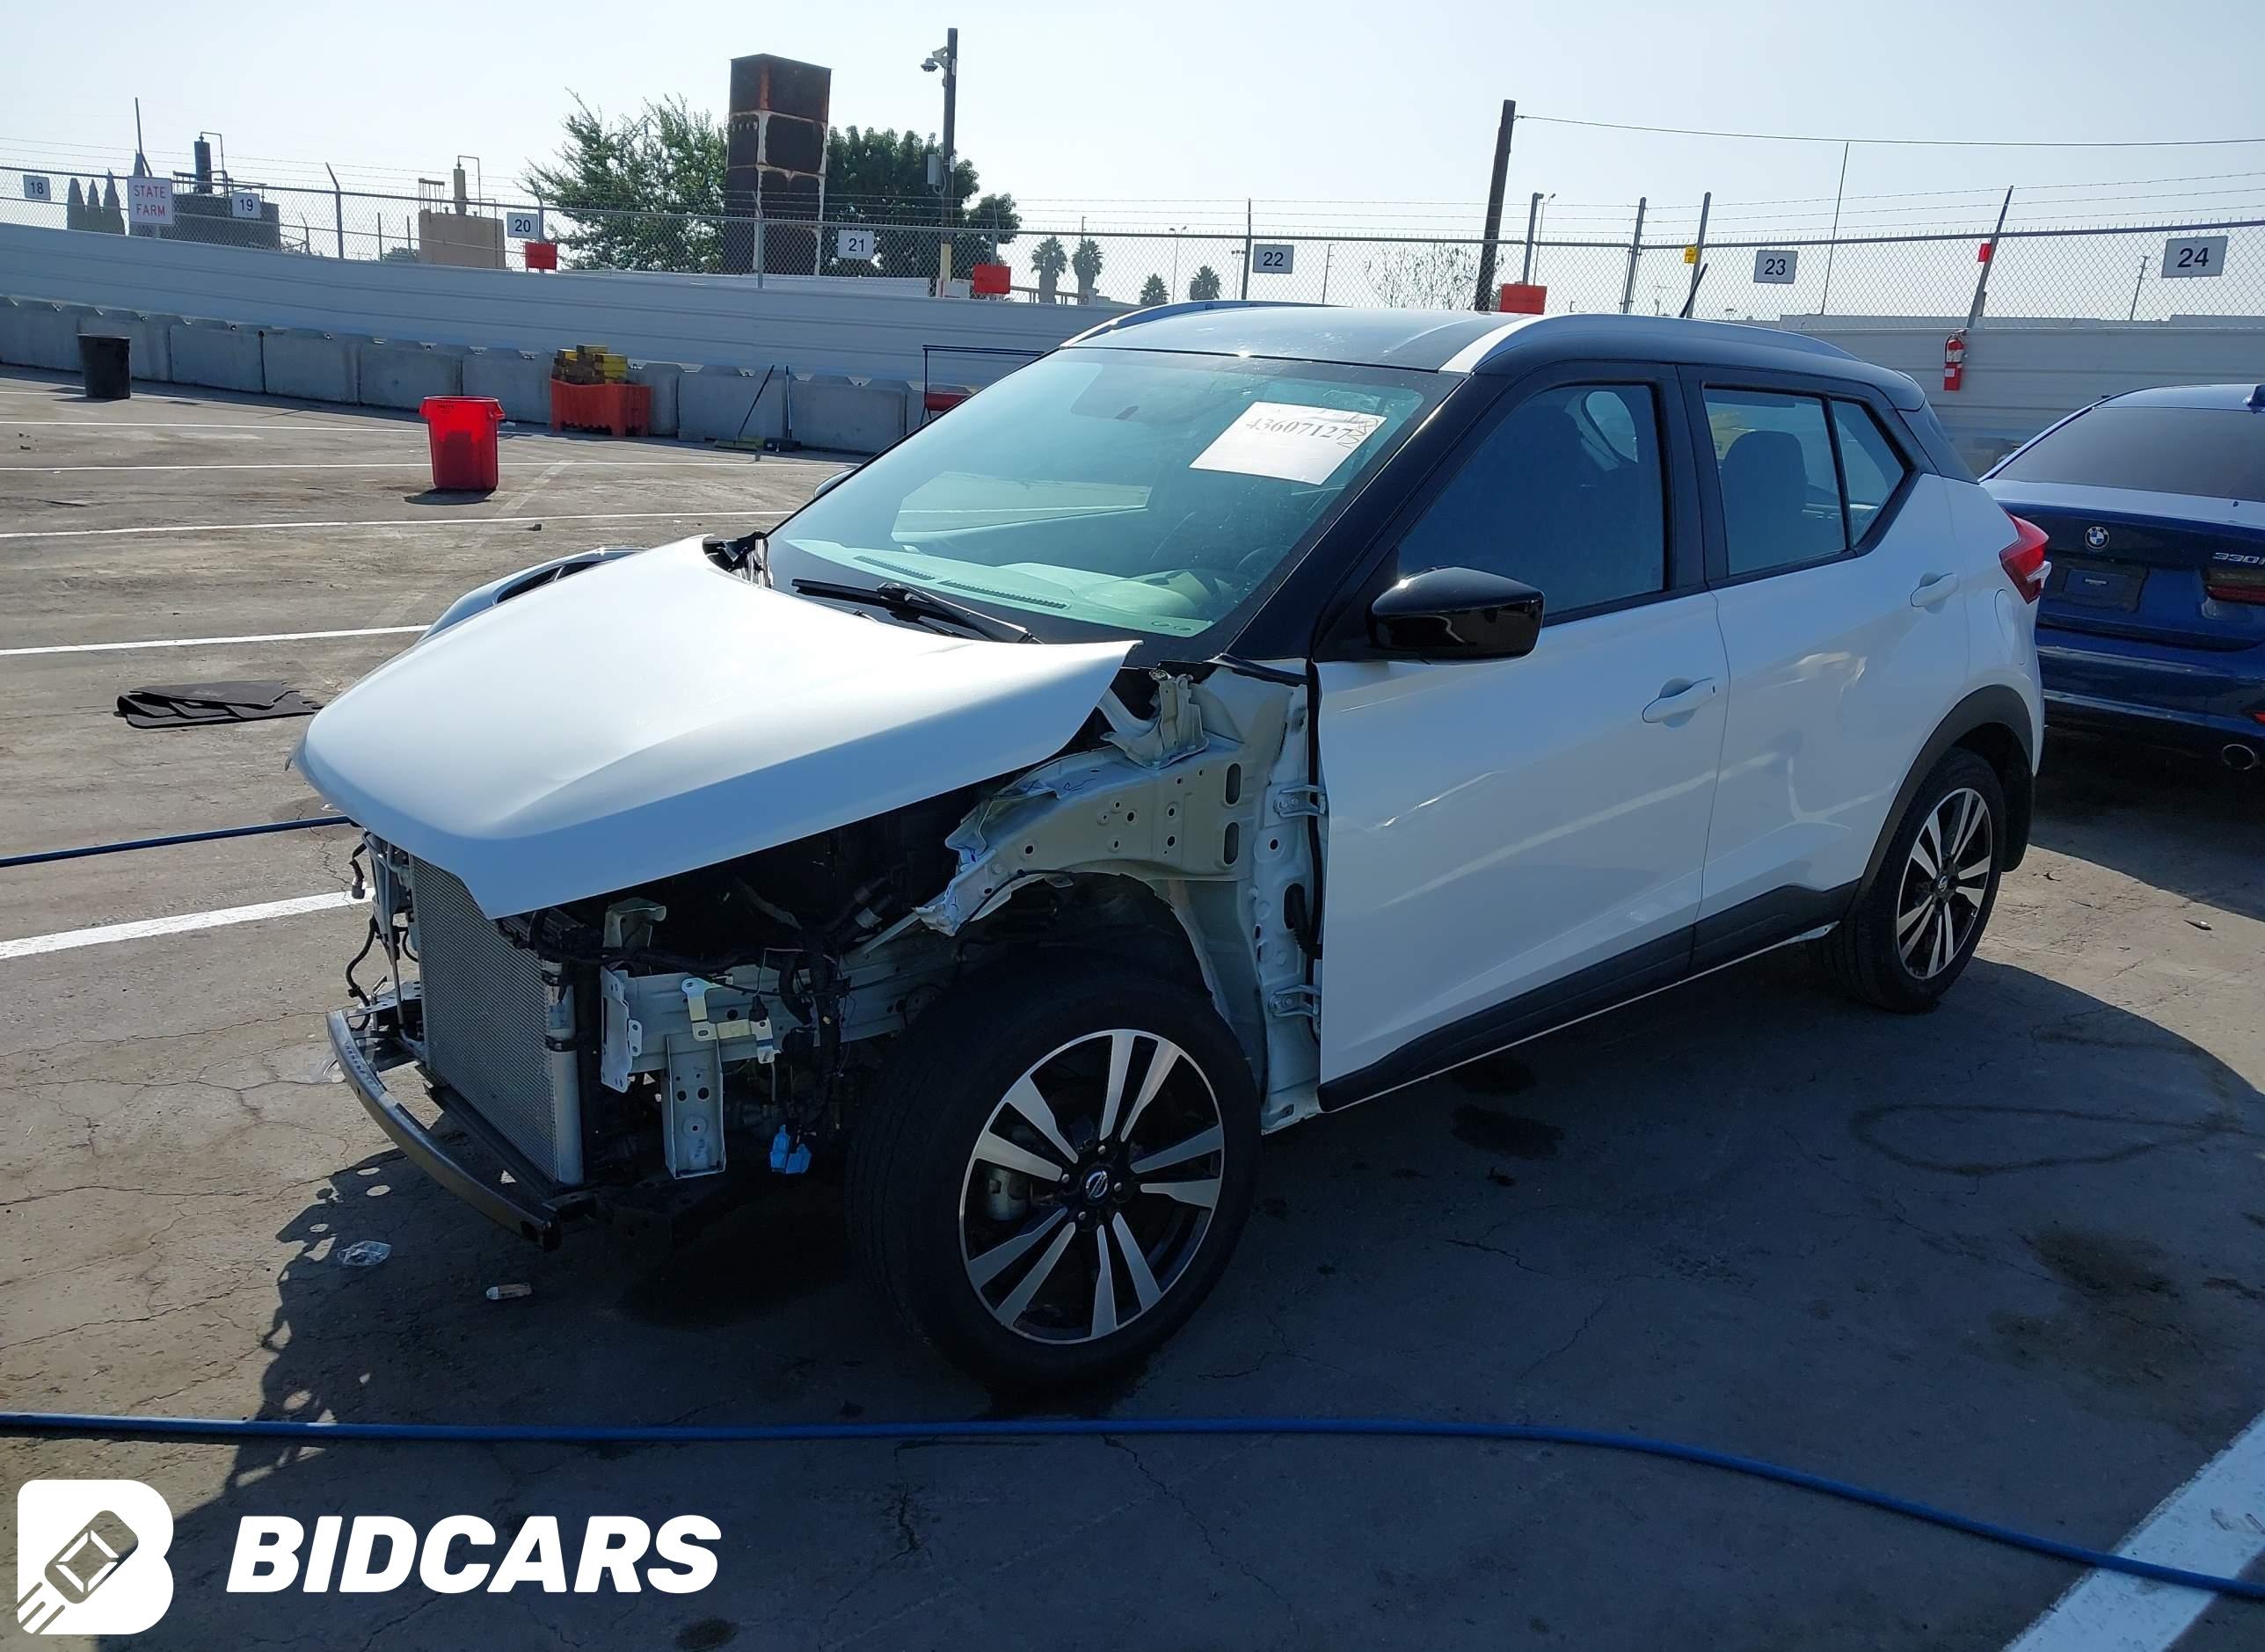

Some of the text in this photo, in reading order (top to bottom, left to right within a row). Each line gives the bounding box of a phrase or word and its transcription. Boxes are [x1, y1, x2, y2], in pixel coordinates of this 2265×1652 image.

[31, 182, 44, 194] 18
[134, 185, 166, 199] STATE
[136, 203, 165, 217] FARM
[240, 199, 253, 211] 19
[514, 219, 531, 232] 20
[848, 238, 864, 251] 21
[1263, 251, 1284, 266] 22
[2177, 247, 2209, 267] 24
[1764, 258, 1786, 275] 23
[1246, 417, 1354, 440] 43607127
